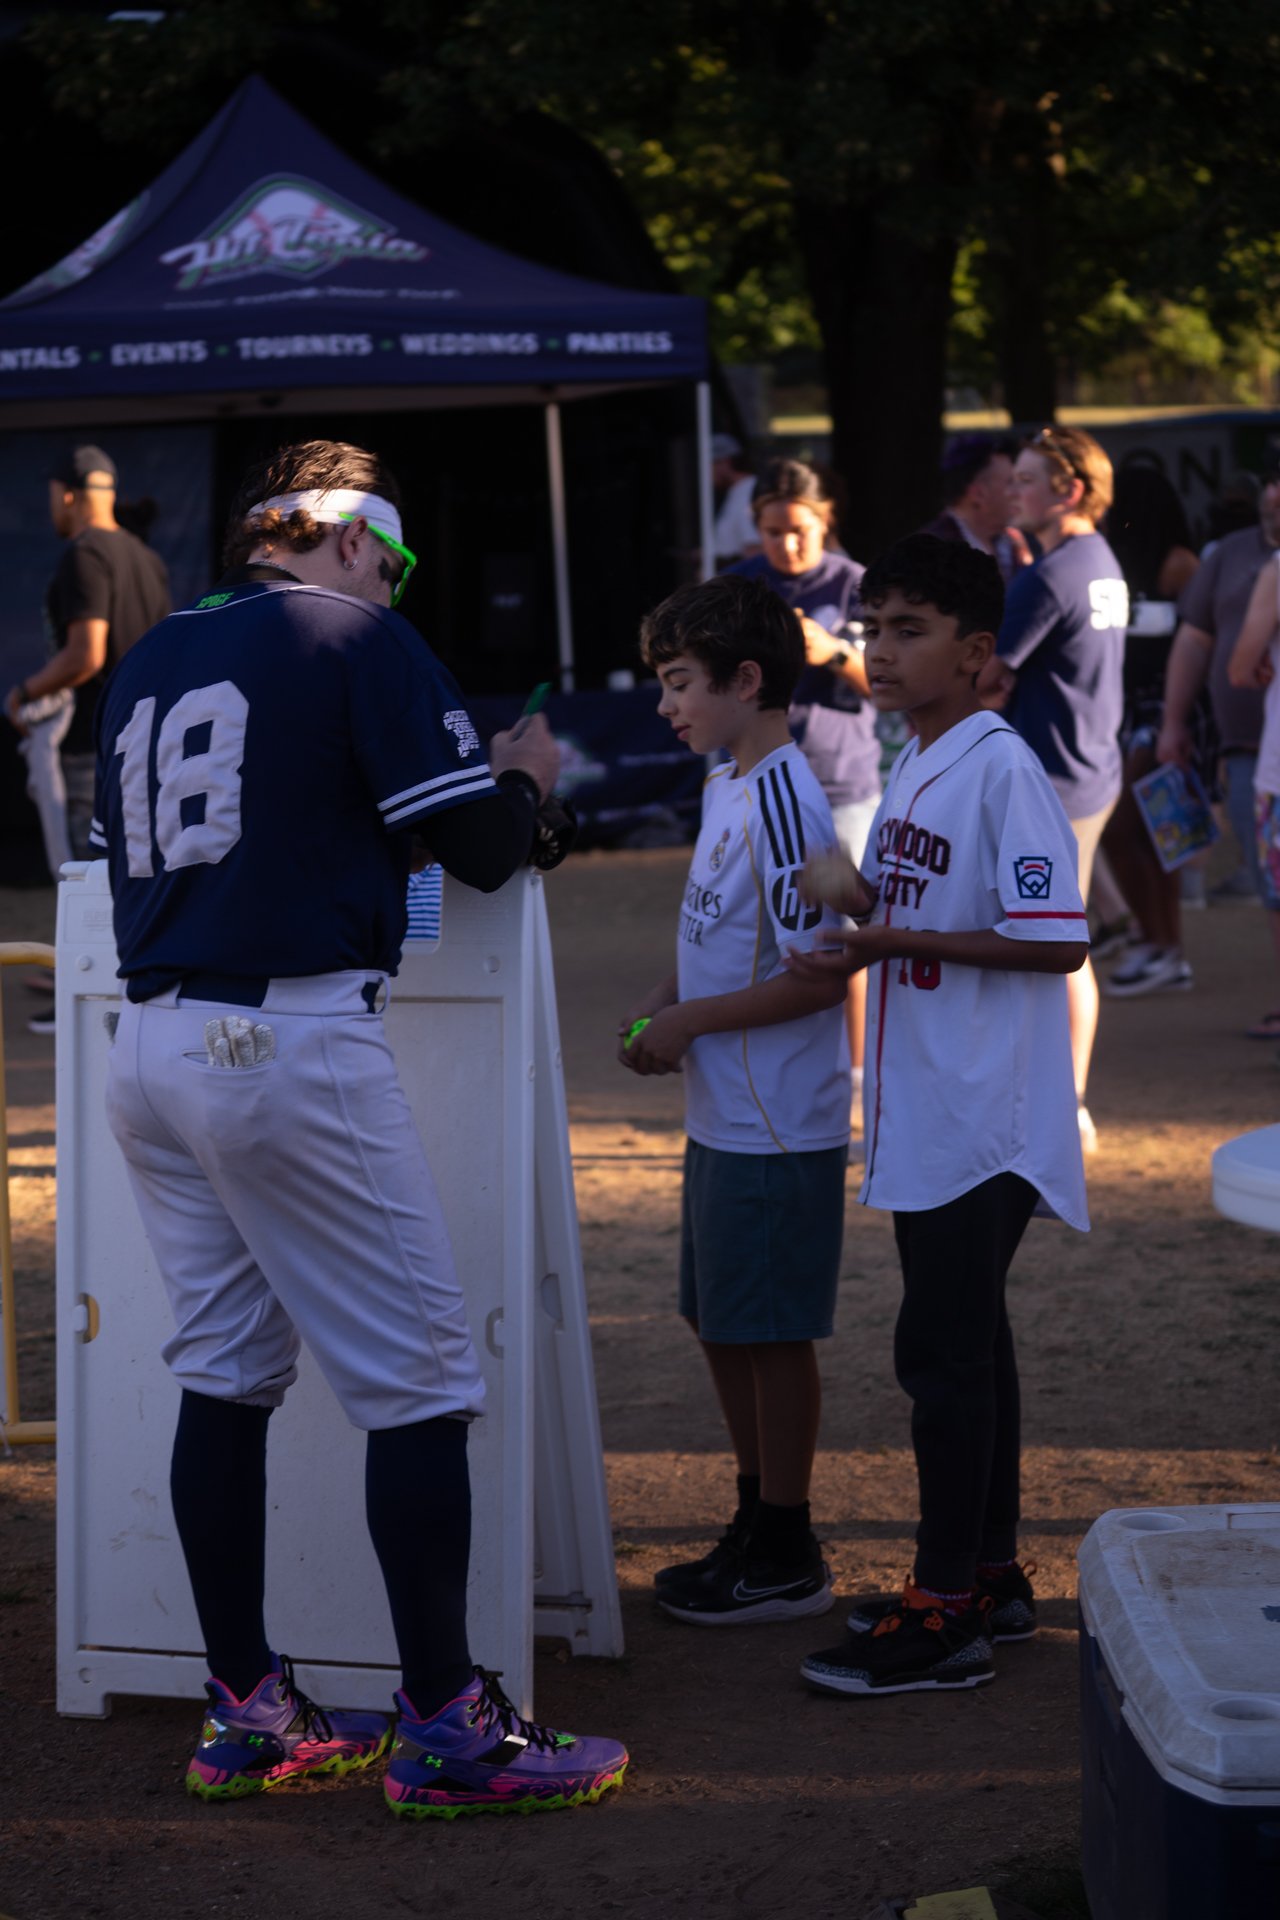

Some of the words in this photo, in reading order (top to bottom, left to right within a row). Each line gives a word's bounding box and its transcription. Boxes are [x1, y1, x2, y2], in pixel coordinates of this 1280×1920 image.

[110, 339, 208, 366] EVENTS
[236, 333, 374, 360] TOURNEYS
[401, 332, 539, 356] WEDDINGS
[566, 330, 673, 354] PARTIES
[113, 679, 251, 879] 18
